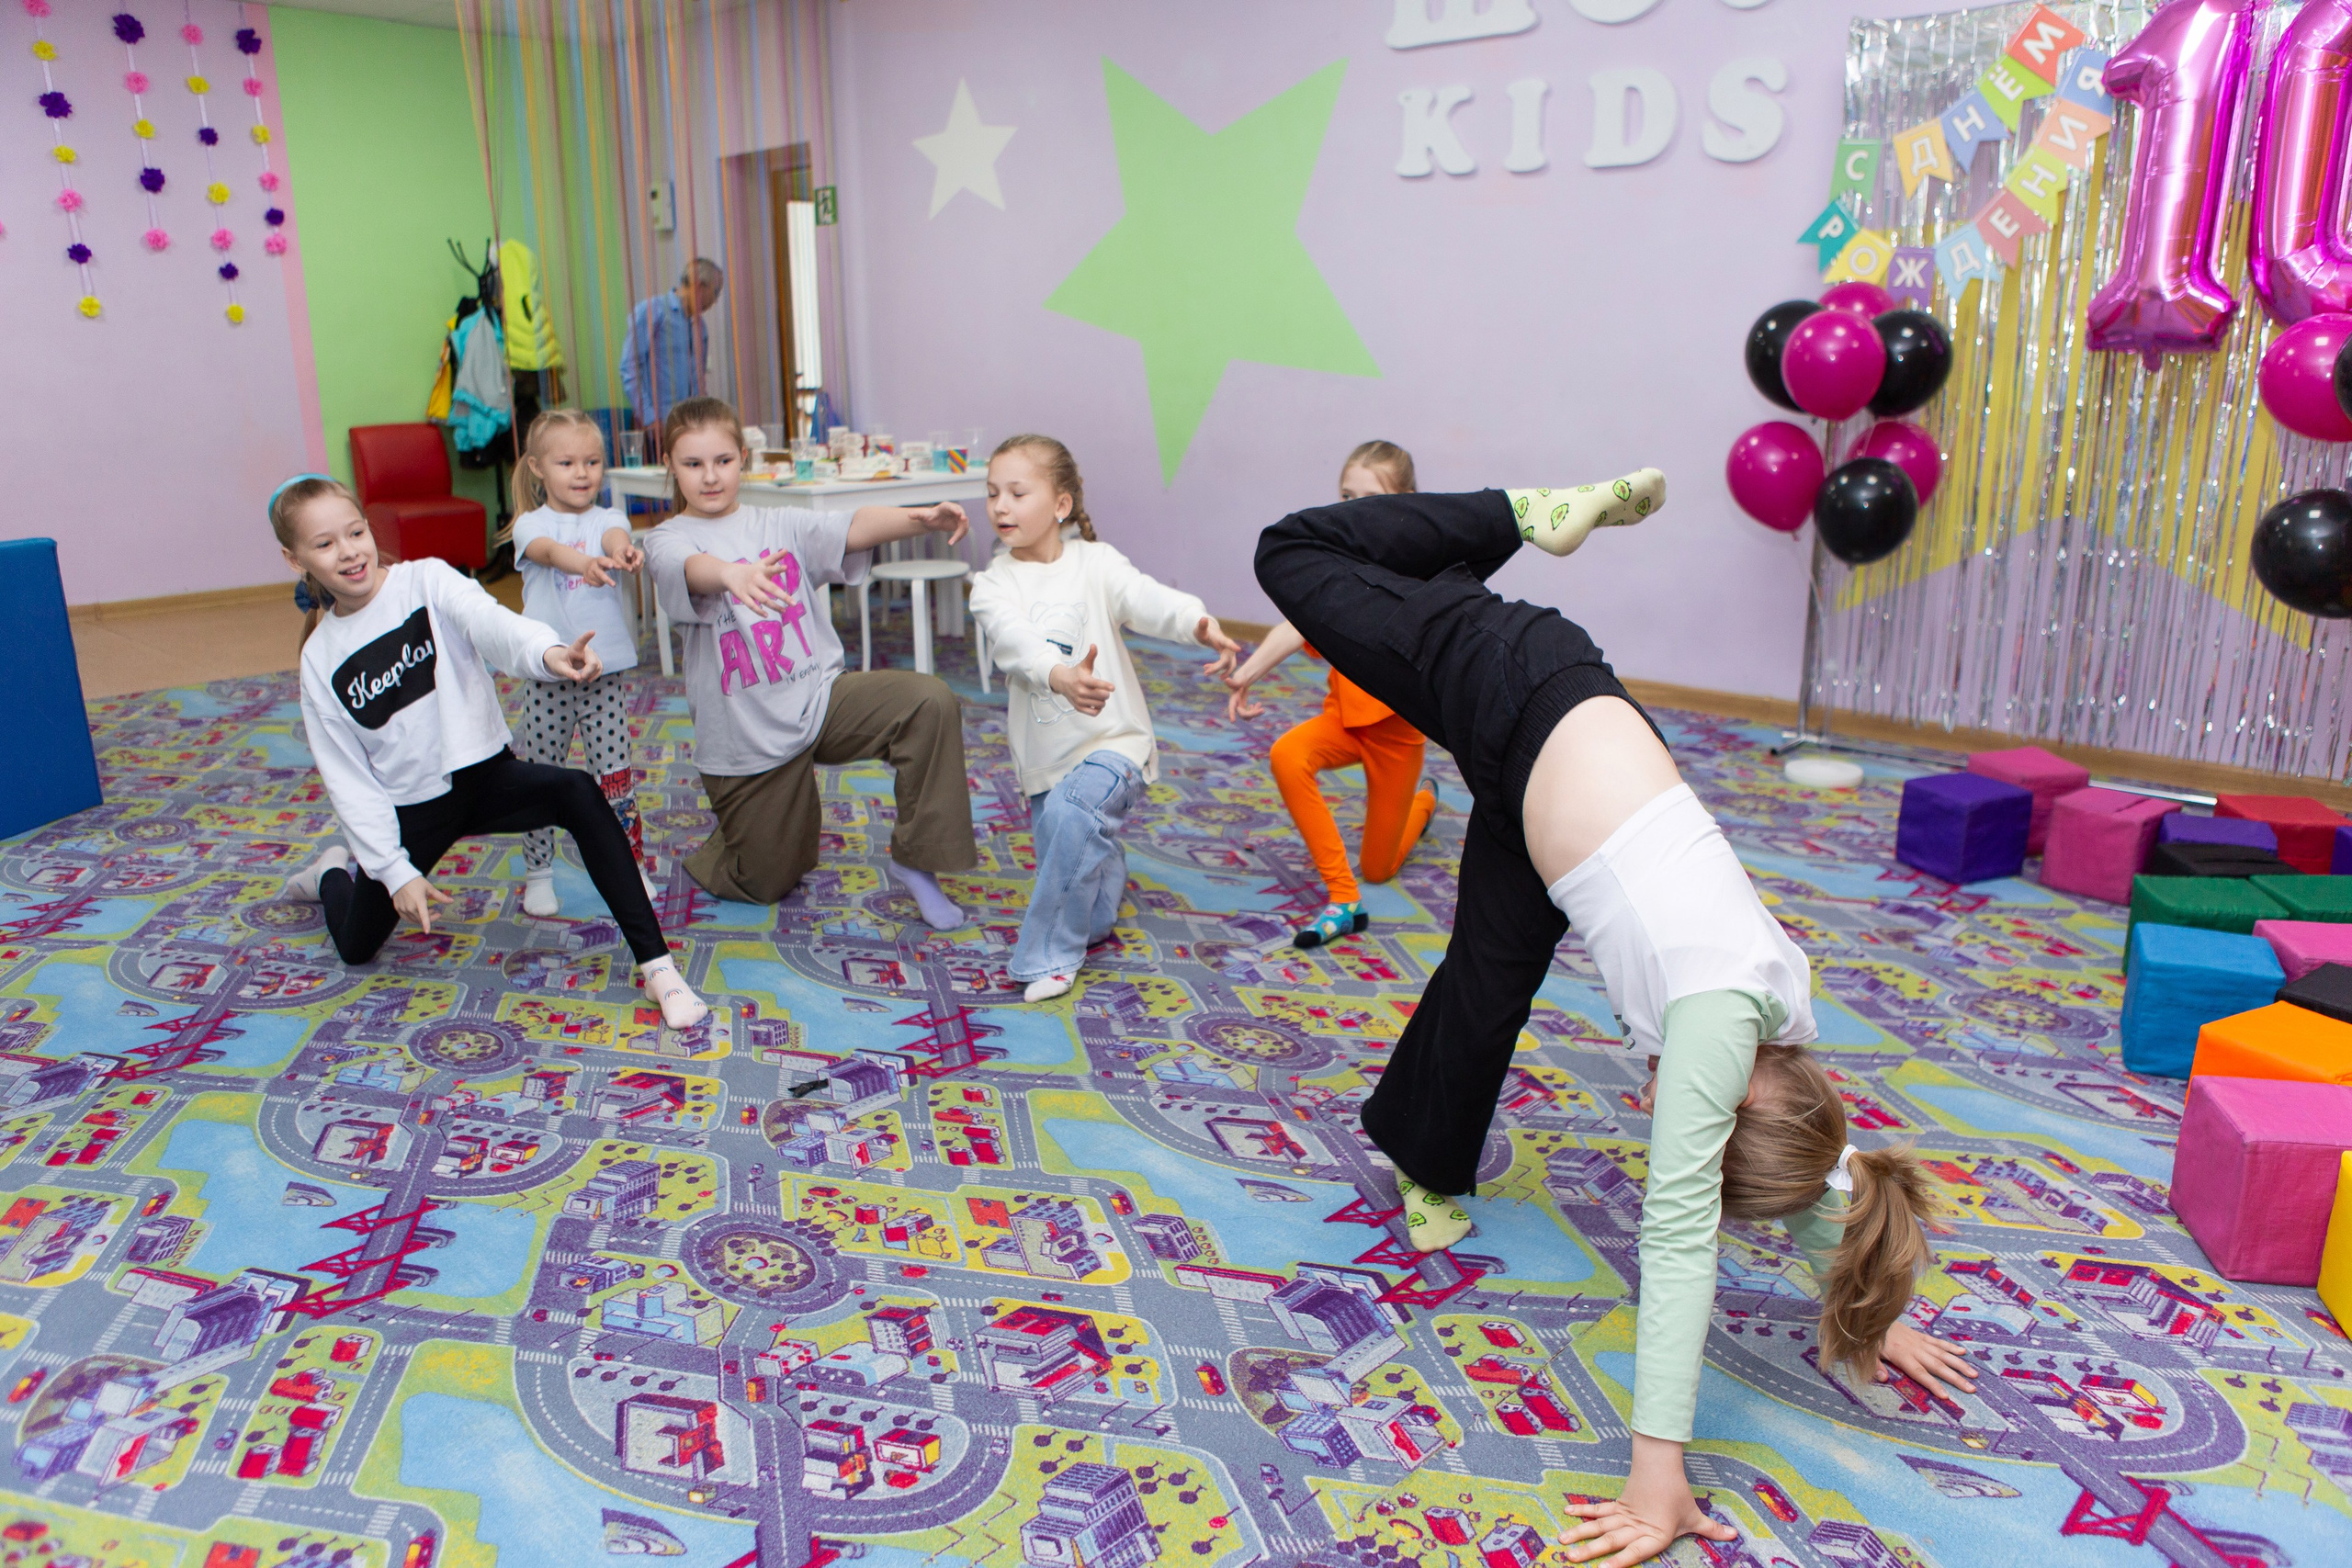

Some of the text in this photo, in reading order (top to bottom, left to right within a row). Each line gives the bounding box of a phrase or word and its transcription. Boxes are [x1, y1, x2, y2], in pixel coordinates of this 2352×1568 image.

[1394, 57, 1789, 177] KIDS
[1909, 22, 2065, 178] ДНЁМ
[1817, 66, 2108, 289] РОЖДЕНИЯ
[719, 600, 812, 697] ART
